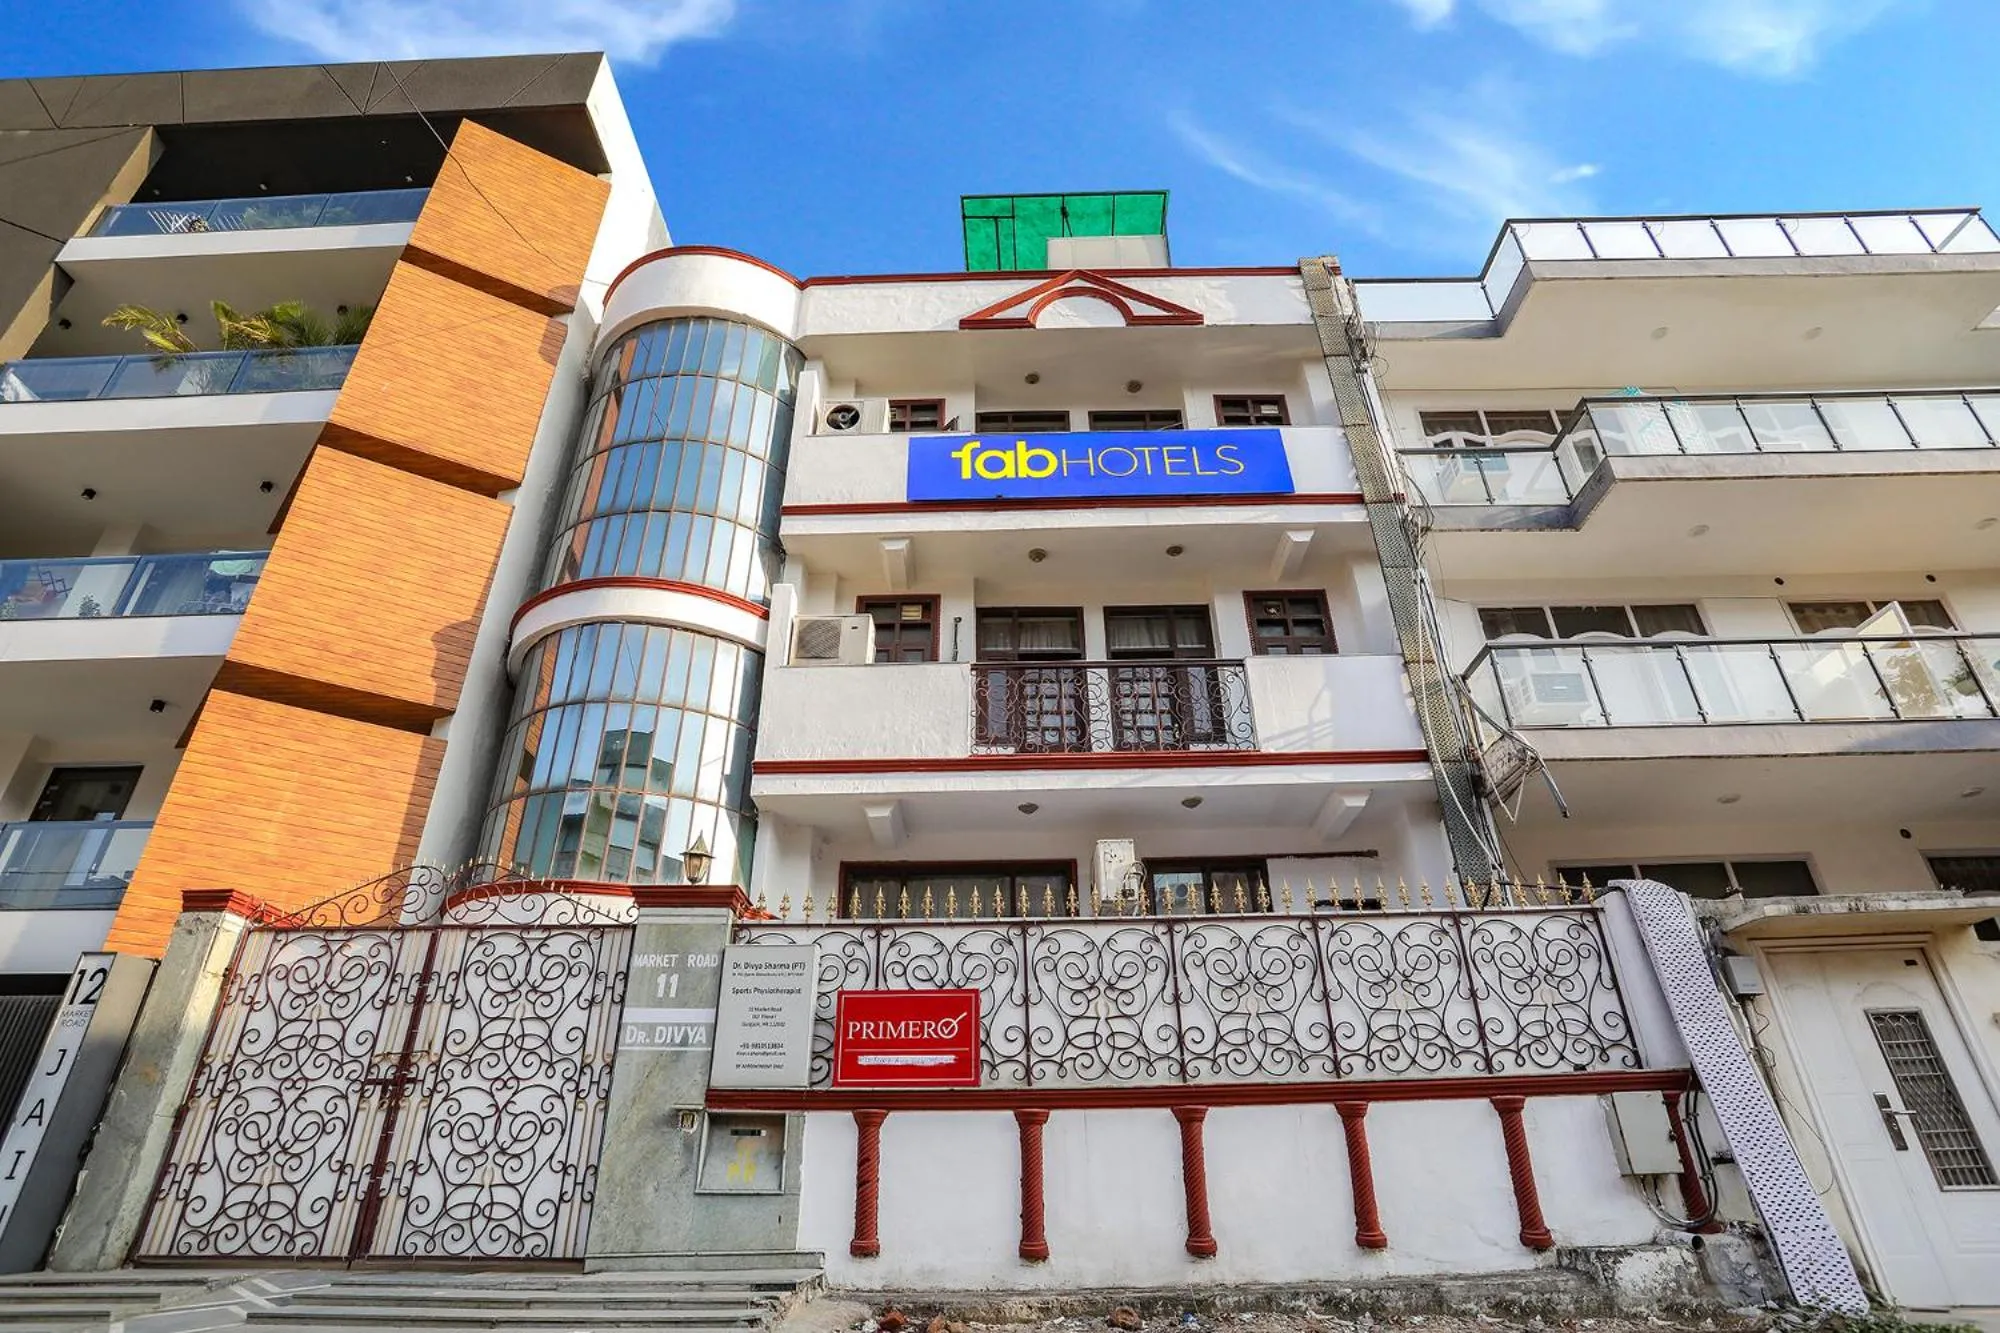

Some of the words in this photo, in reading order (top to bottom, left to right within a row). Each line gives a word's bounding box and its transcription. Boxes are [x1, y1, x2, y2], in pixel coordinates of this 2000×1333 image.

[633, 954, 679, 968] MARKET
[687, 954, 719, 967] ROAD
[744, 962, 763, 970] Divya
[764, 962, 790, 970] Sharma
[791, 962, 806, 970] (PT)
[68, 968, 109, 1006] 12
[656, 973, 680, 998] 11
[732, 987, 753, 995] Sports
[753, 987, 801, 995] Physiotherapist
[654, 1025, 707, 1044] DIVYA
[846, 1013, 967, 1041] PRIMERO
